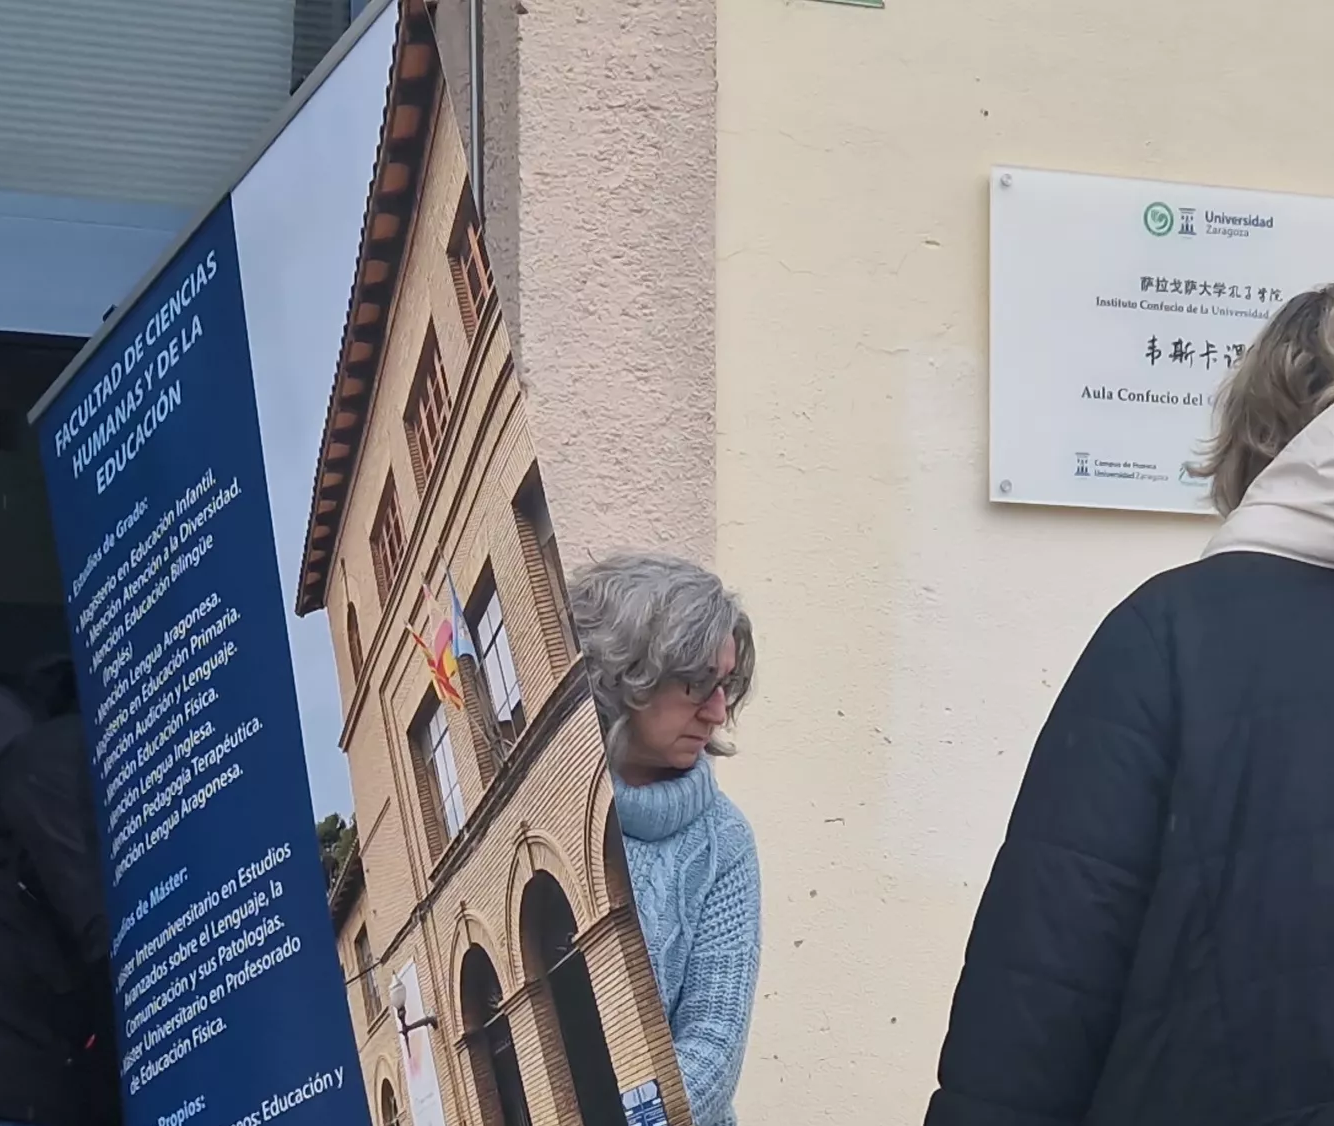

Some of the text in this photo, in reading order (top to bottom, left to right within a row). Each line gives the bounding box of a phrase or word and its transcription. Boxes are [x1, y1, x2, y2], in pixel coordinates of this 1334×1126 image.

[1205, 211, 1274, 228] Universidad
[1205, 225, 1249, 238] Zaragoza
[54, 249, 218, 457] FACULTAD DE CIENCIAS
[1096, 296, 1270, 320] Instituto Confucio de la Universidad
[72, 314, 203, 480] HUMANAS Y DE LA
[95, 380, 182, 495] EDUCACIÓN
[1081, 385, 1113, 401] Aula
[1117, 388, 1179, 405] Confucio
[1182, 392, 1204, 407] del
[116, 497, 148, 539] Grado:
[117, 561, 130, 581] en
[130, 508, 175, 568] Educación
[175, 467, 216, 517] Infantil.
[122, 553, 162, 606] Atención
[163, 547, 169, 562] a
[169, 535, 179, 553] la
[179, 476, 242, 543] Diversidad.
[124, 575, 170, 632] Educación
[170, 534, 214, 583] Bilingüe
[102, 640, 133, 687] (Inglés)
[129, 642, 163, 686] Lengua
[163, 591, 221, 651] Aragonesa.
[129, 695, 142, 715] en
[141, 645, 189, 703] Educación
[190, 607, 241, 656] Primaria.
[135, 684, 174, 741] Audición
[174, 683, 181, 703] y
[182, 640, 237, 693] Lenguaje.
[137, 713, 184, 767] Educación
[184, 686, 219, 722] Física.
[139, 756, 174, 795] Lengua
[174, 720, 215, 764] Inglesa.
[142, 765, 192, 823] Pedagogía
[191, 715, 263, 778] Terapéutica.
[145, 808, 180, 850] Lengua
[180, 763, 243, 818] Aragonesa.
[135, 899, 149, 921] de
[149, 866, 189, 909] Máster:
[135, 889, 220, 967] Interuniversitario
[220, 879, 237, 899] en
[237, 841, 292, 888] Estudios
[168, 938, 199, 971] sobre
[199, 927, 211, 948] el
[211, 892, 269, 939] Lenguaje,
[269, 879, 284, 899] la
[125, 913, 285, 1038] Comunicación y sus Patologías.
[143, 994, 208, 1051] Universitario
[208, 983, 226, 1004] en
[225, 934, 302, 995] Profesorado
[130, 1016, 228, 1095] de Educación Física.
[261, 1071, 333, 1122] Educación
[333, 1065, 345, 1088] y
